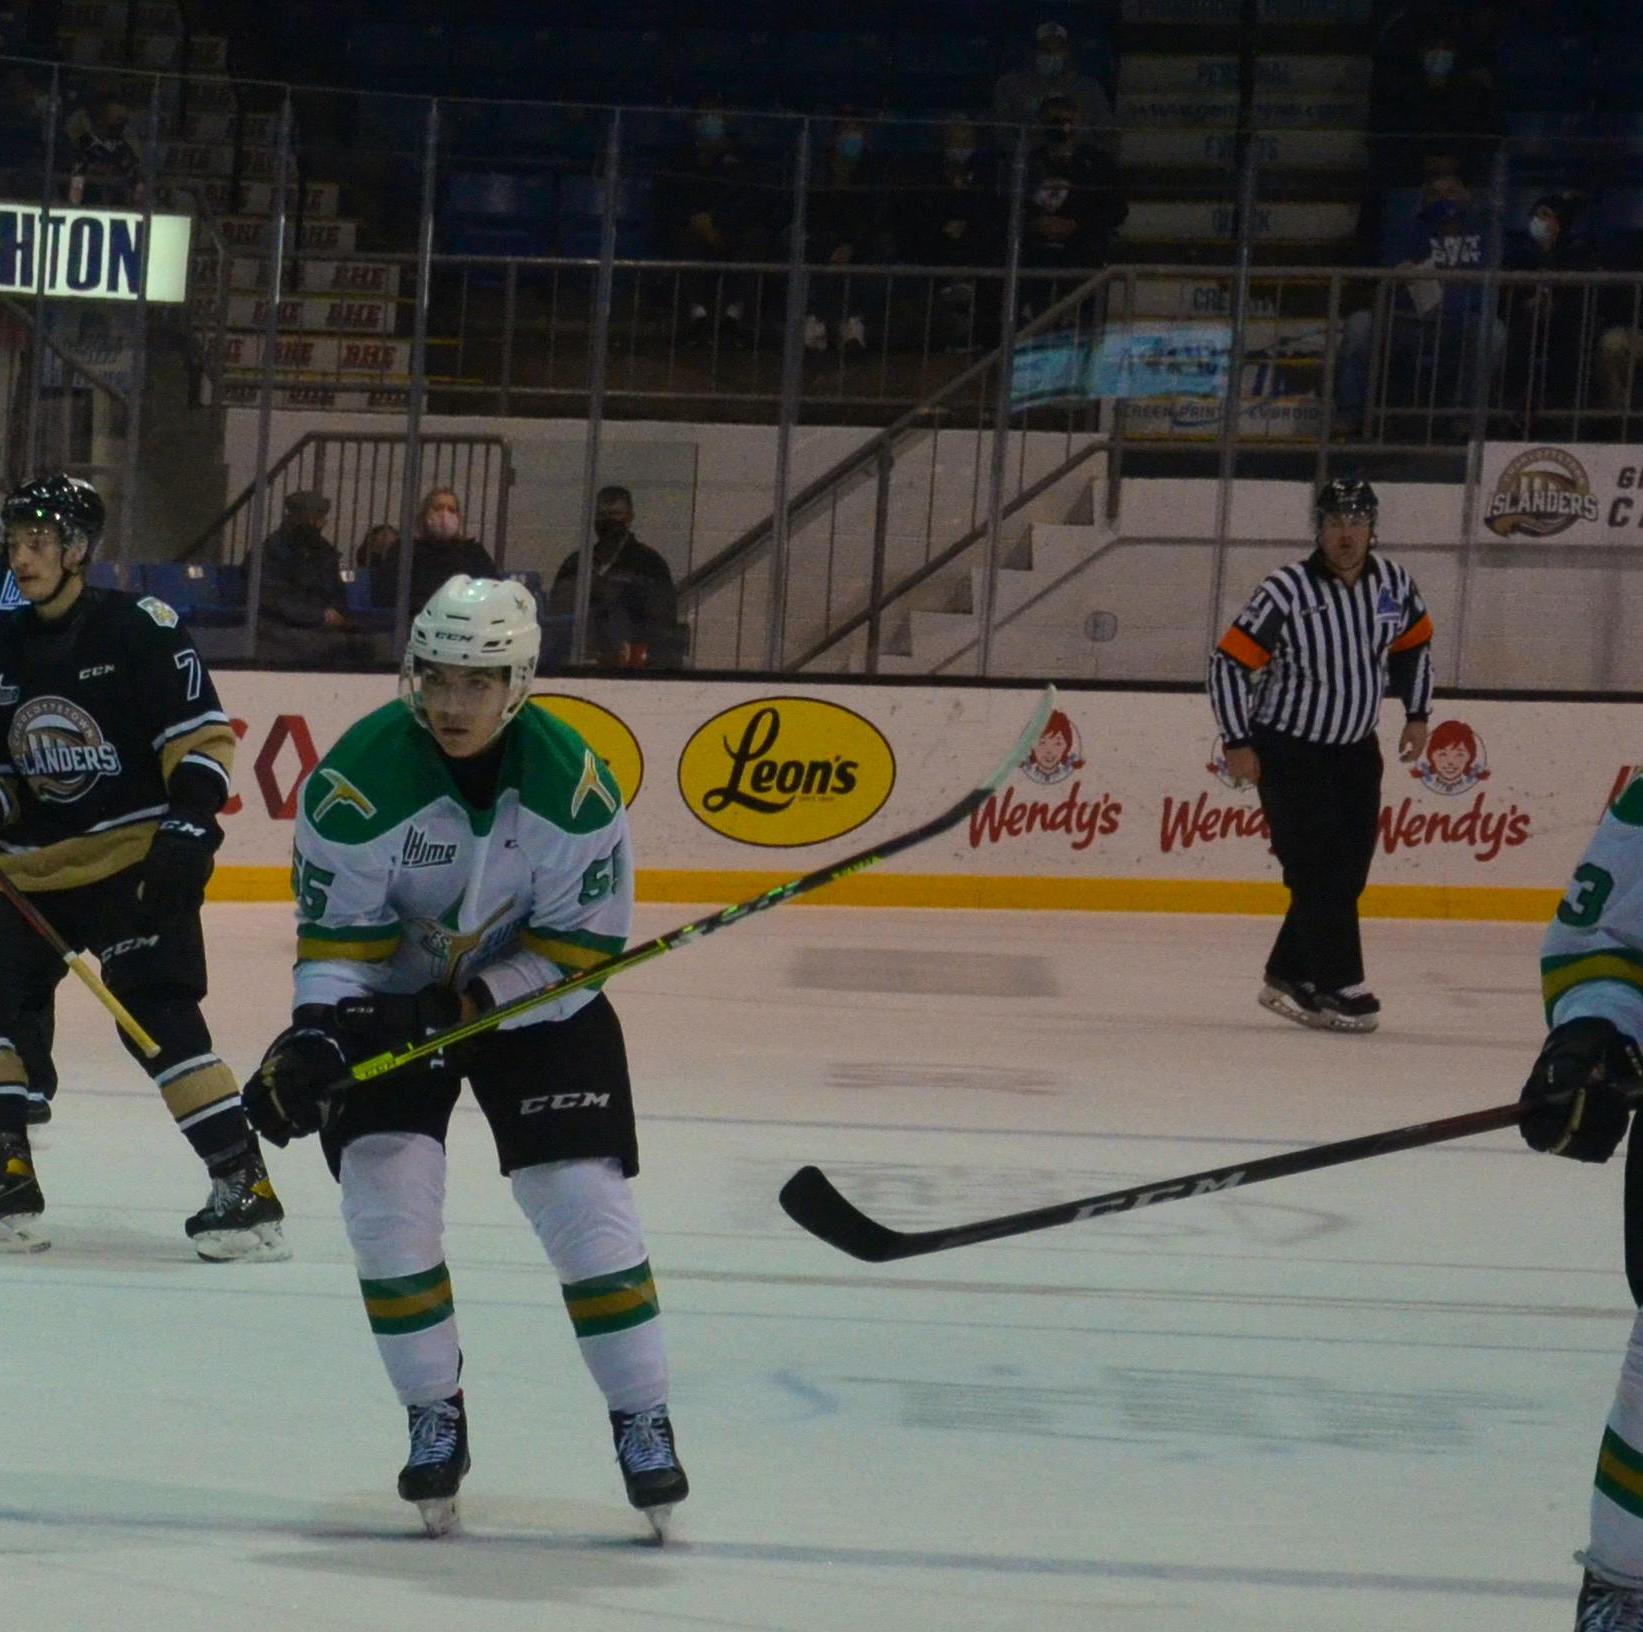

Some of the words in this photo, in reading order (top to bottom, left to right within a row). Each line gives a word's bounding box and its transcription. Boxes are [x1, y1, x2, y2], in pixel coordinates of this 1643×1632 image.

[173, 648, 203, 701] 7
[702, 706, 859, 814] Leon's
[968, 781, 1123, 852] Wendy's
[1374, 791, 1532, 862] Wendy's
[1556, 861, 1615, 929] 3
[519, 1091, 611, 1116] CCM
